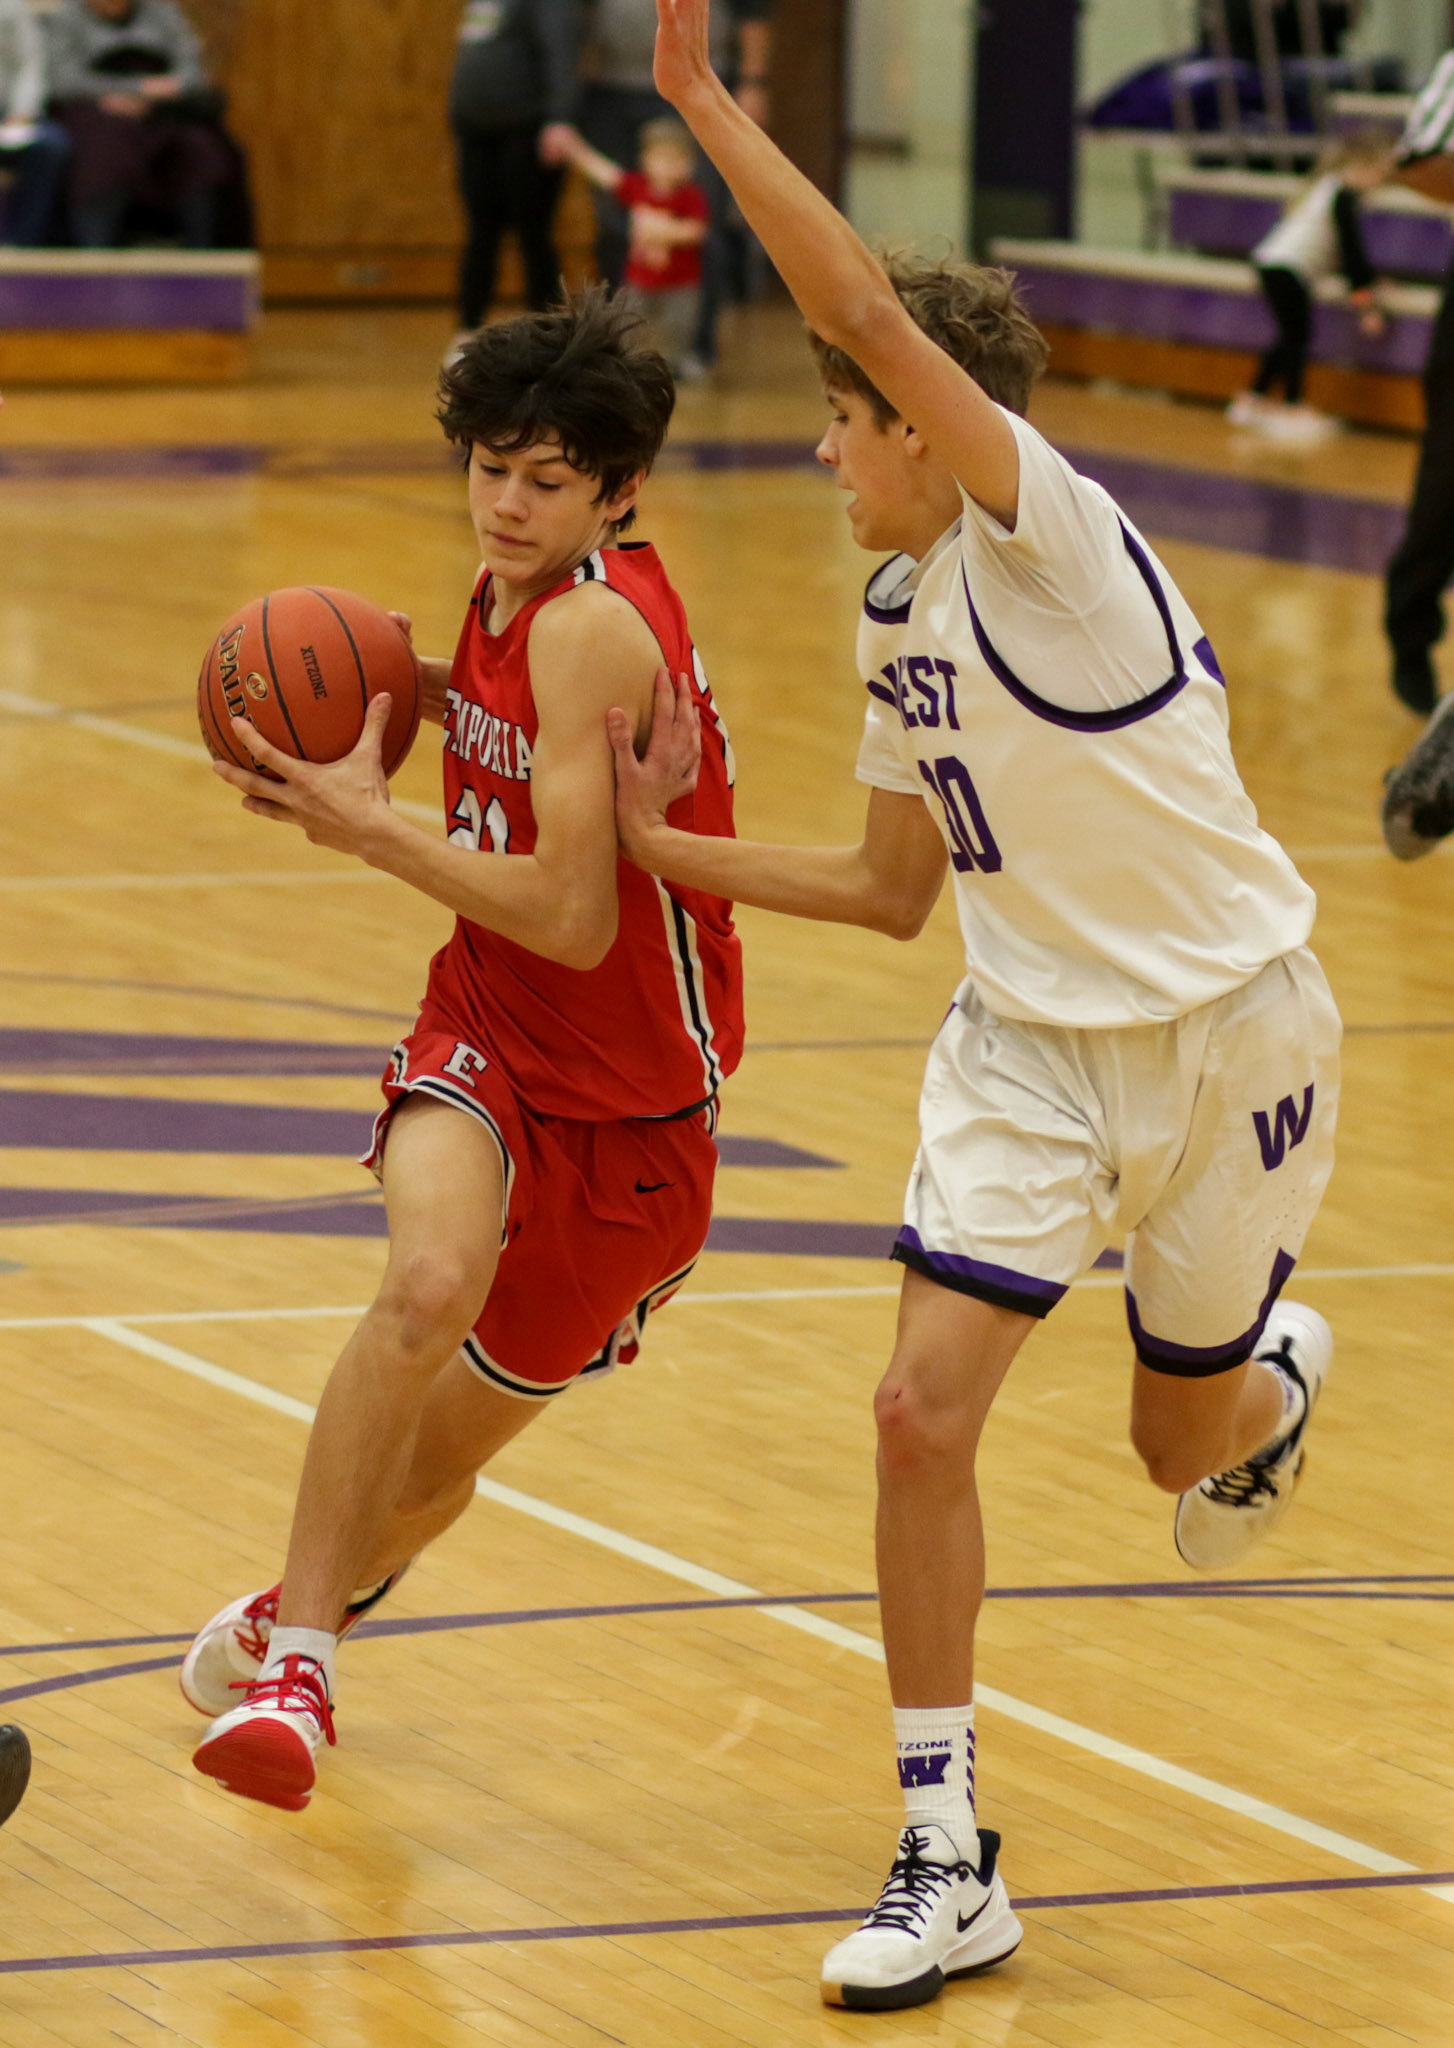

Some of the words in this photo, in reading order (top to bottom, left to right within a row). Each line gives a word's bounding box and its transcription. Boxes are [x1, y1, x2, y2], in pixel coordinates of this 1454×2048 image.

[442, 1041, 488, 1089] E
[1251, 1081, 1314, 1172] W
[897, 1739, 952, 1751] TZONE
